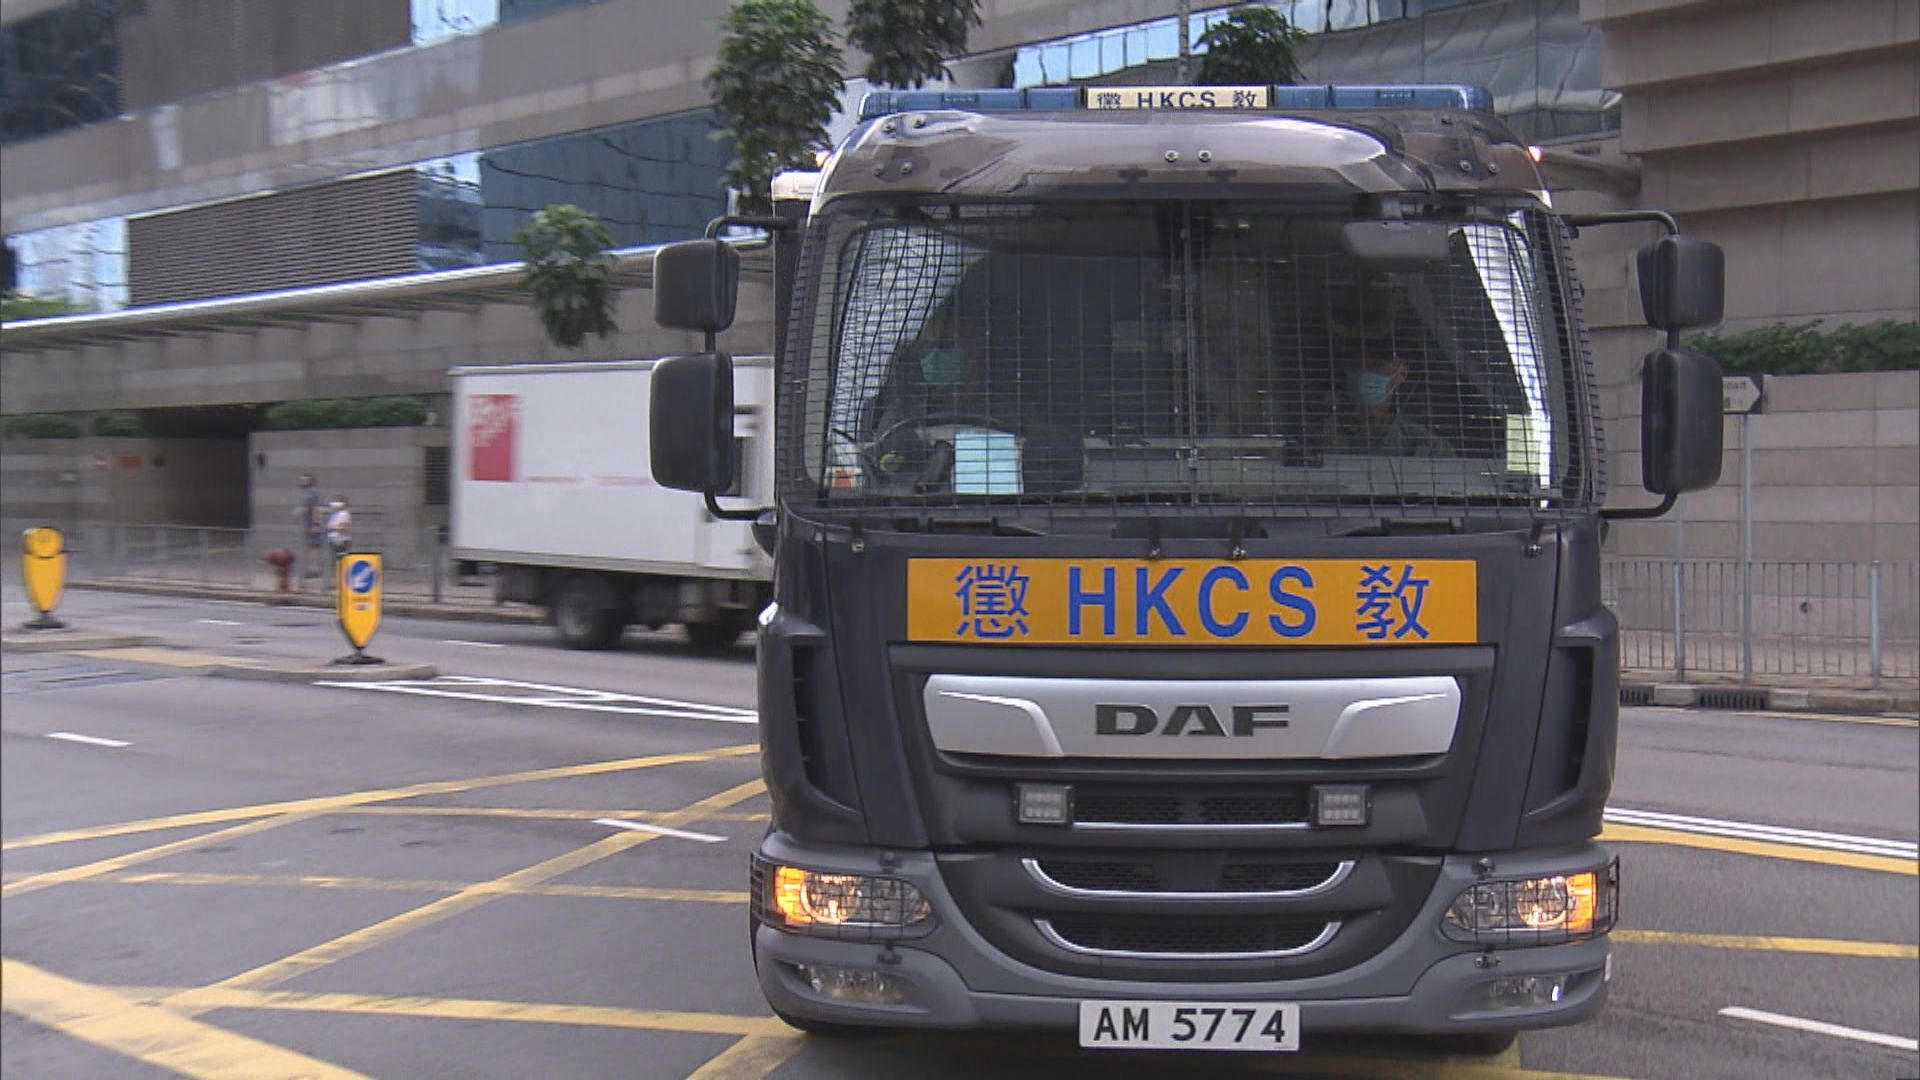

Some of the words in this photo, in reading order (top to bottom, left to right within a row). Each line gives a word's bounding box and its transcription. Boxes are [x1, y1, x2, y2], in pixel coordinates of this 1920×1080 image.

[1137, 92, 1215, 108] HKCS
[955, 564, 1030, 637] 懲
[1068, 565, 1316, 637] HKCS
[1096, 704, 1289, 736] DAF
[1093, 1007, 1149, 1041] AM
[1171, 1008, 1285, 1043] 5774
